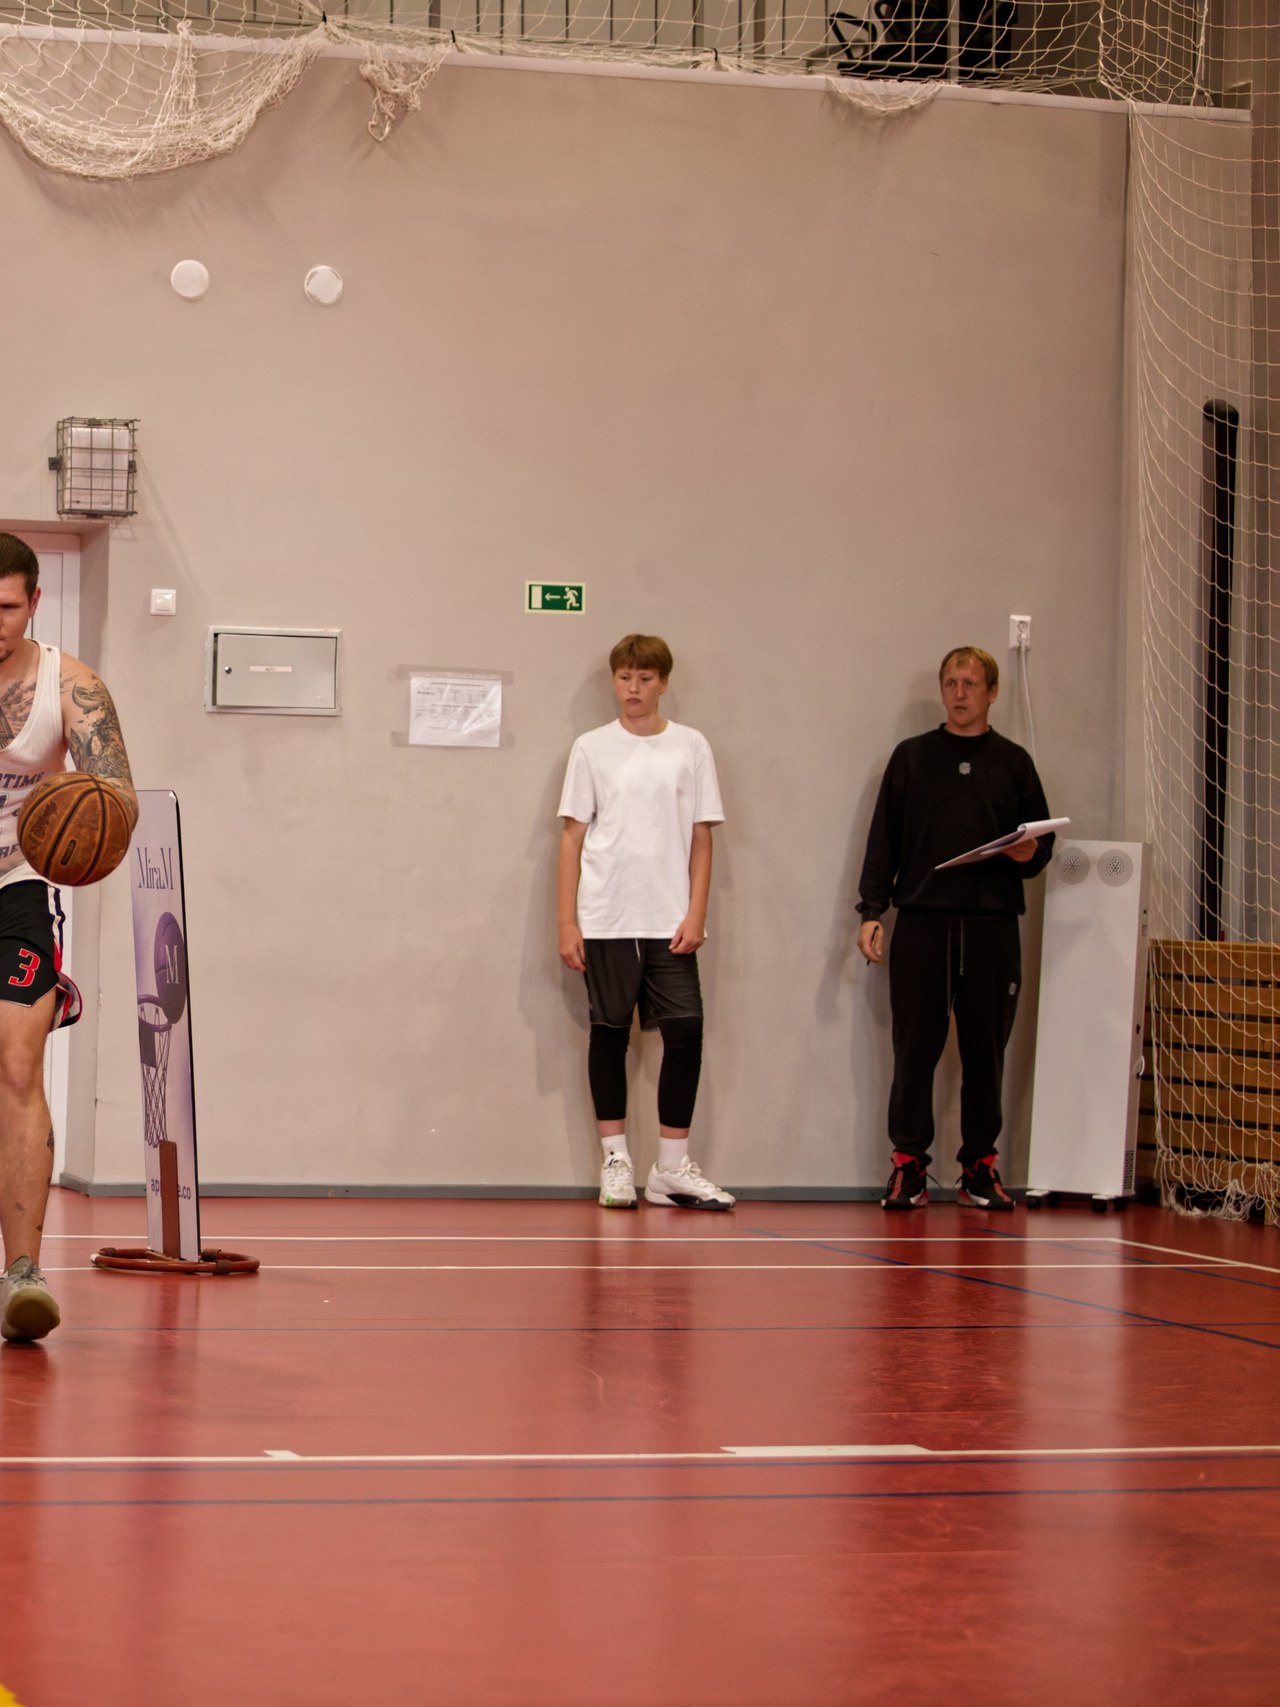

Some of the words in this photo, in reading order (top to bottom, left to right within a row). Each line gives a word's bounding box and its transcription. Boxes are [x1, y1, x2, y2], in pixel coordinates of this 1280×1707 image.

[136, 847, 174, 889] MiraM
[8, 947, 41, 987] 3
[163, 944, 180, 984] M
